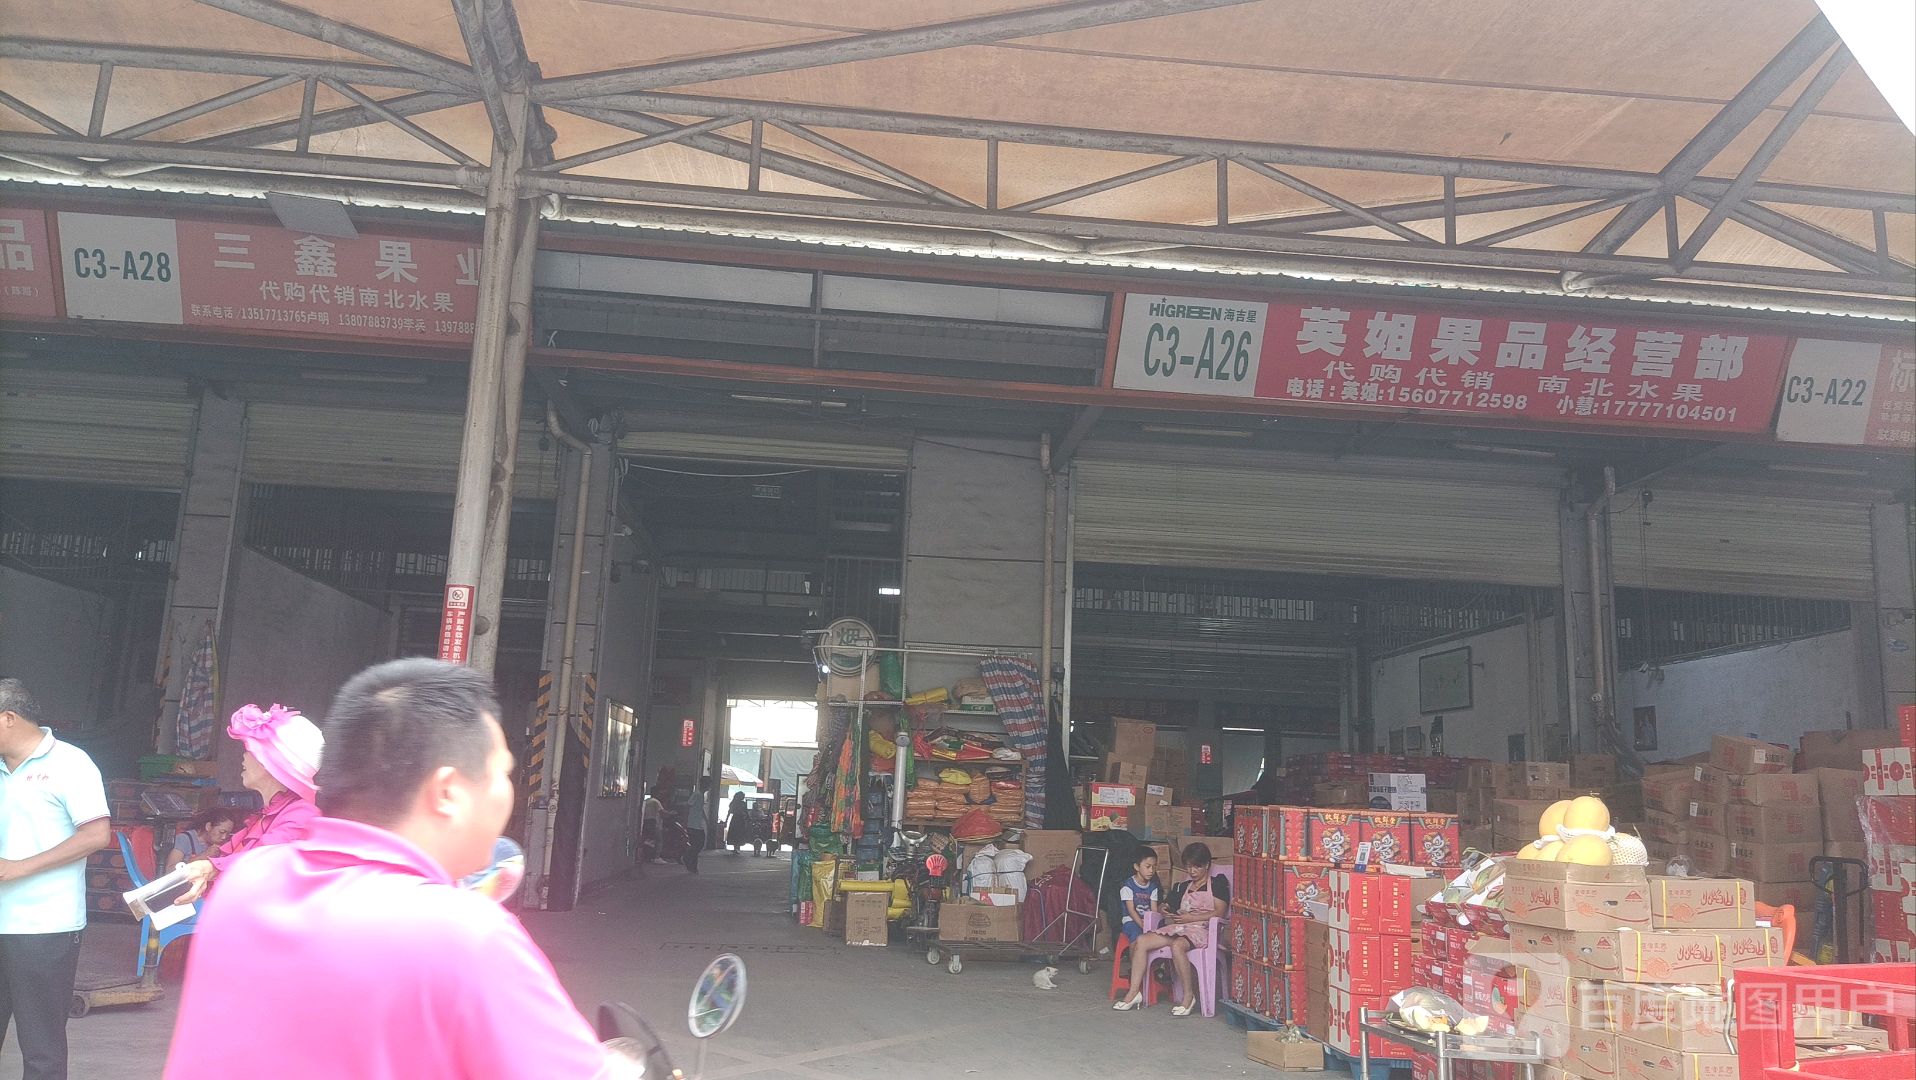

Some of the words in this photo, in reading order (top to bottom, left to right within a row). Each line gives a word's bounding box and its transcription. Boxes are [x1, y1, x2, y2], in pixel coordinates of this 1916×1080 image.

[74, 247, 172, 282] C3-A28
[260, 280, 454, 313] 代购代销南北水果
[1224, 308, 1257, 324] 海吉星
[1144, 322, 1252, 382] C3-A26
[1296, 306, 1749, 382] 英姐果品经营部
[1322, 360, 1494, 391] 代购代销
[1538, 375, 1703, 402] 南北水果
[1787, 375, 1867, 406] C3-A22
